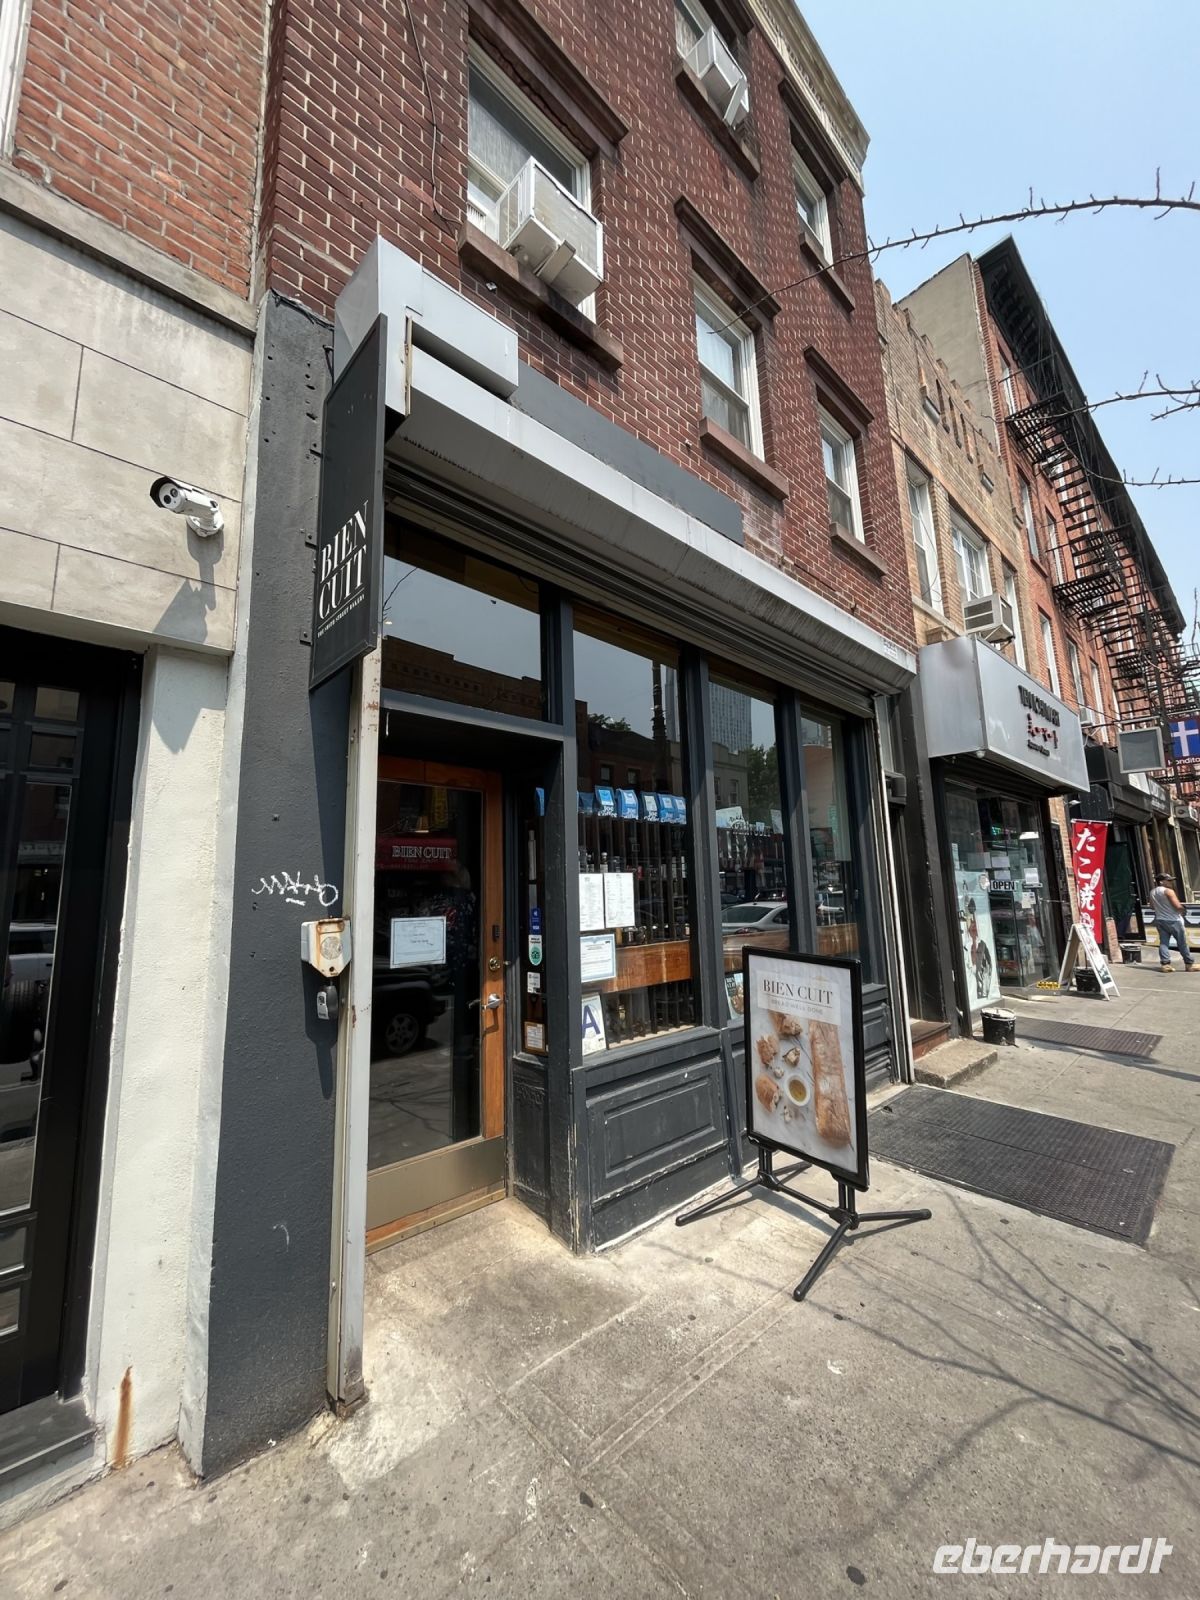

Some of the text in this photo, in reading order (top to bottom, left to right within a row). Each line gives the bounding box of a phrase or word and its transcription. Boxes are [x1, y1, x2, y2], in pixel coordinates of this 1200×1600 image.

[319, 500, 368, 584] BIEN
[318, 544, 367, 620] CUIT
[392, 846, 452, 859] BIEN CUIT
[993, 881, 1015, 890] OPEN
[763, 979, 833, 1004] BIEN CUIT
[581, 1005, 601, 1039] A
